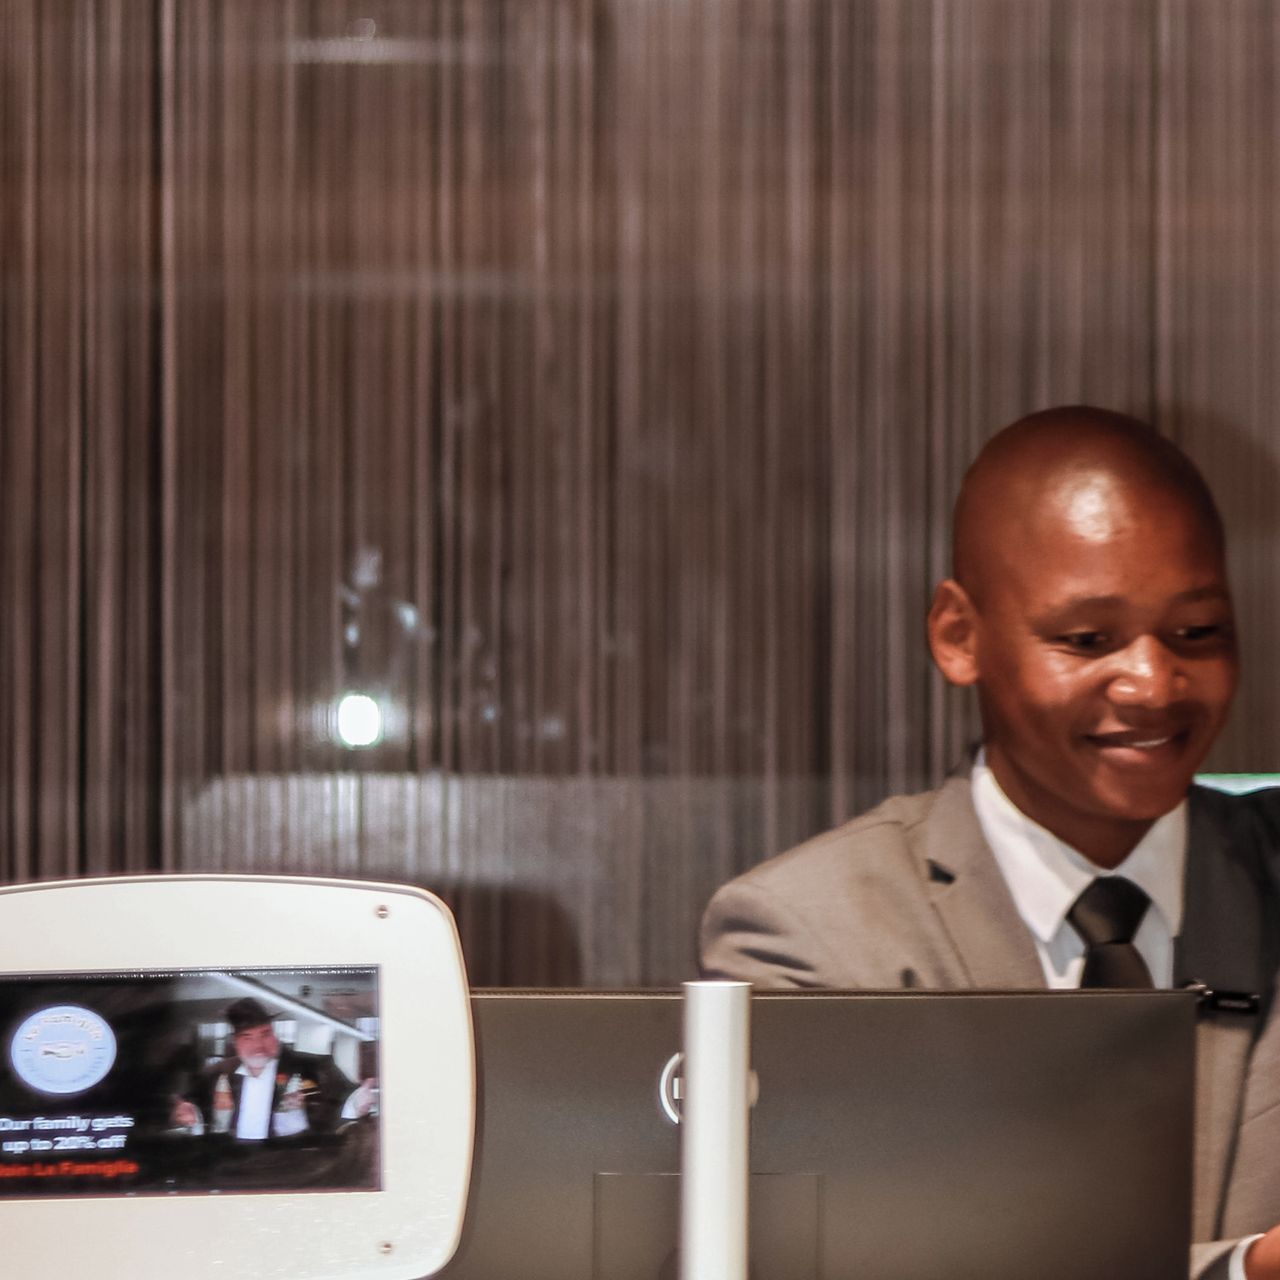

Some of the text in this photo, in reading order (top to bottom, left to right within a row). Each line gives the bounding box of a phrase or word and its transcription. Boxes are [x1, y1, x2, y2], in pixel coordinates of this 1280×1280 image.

[0, 1116, 135, 1132] Our family gets
[2, 1141, 29, 1154] up
[30, 1139, 53, 1150] to
[97, 1135, 128, 1148] off
